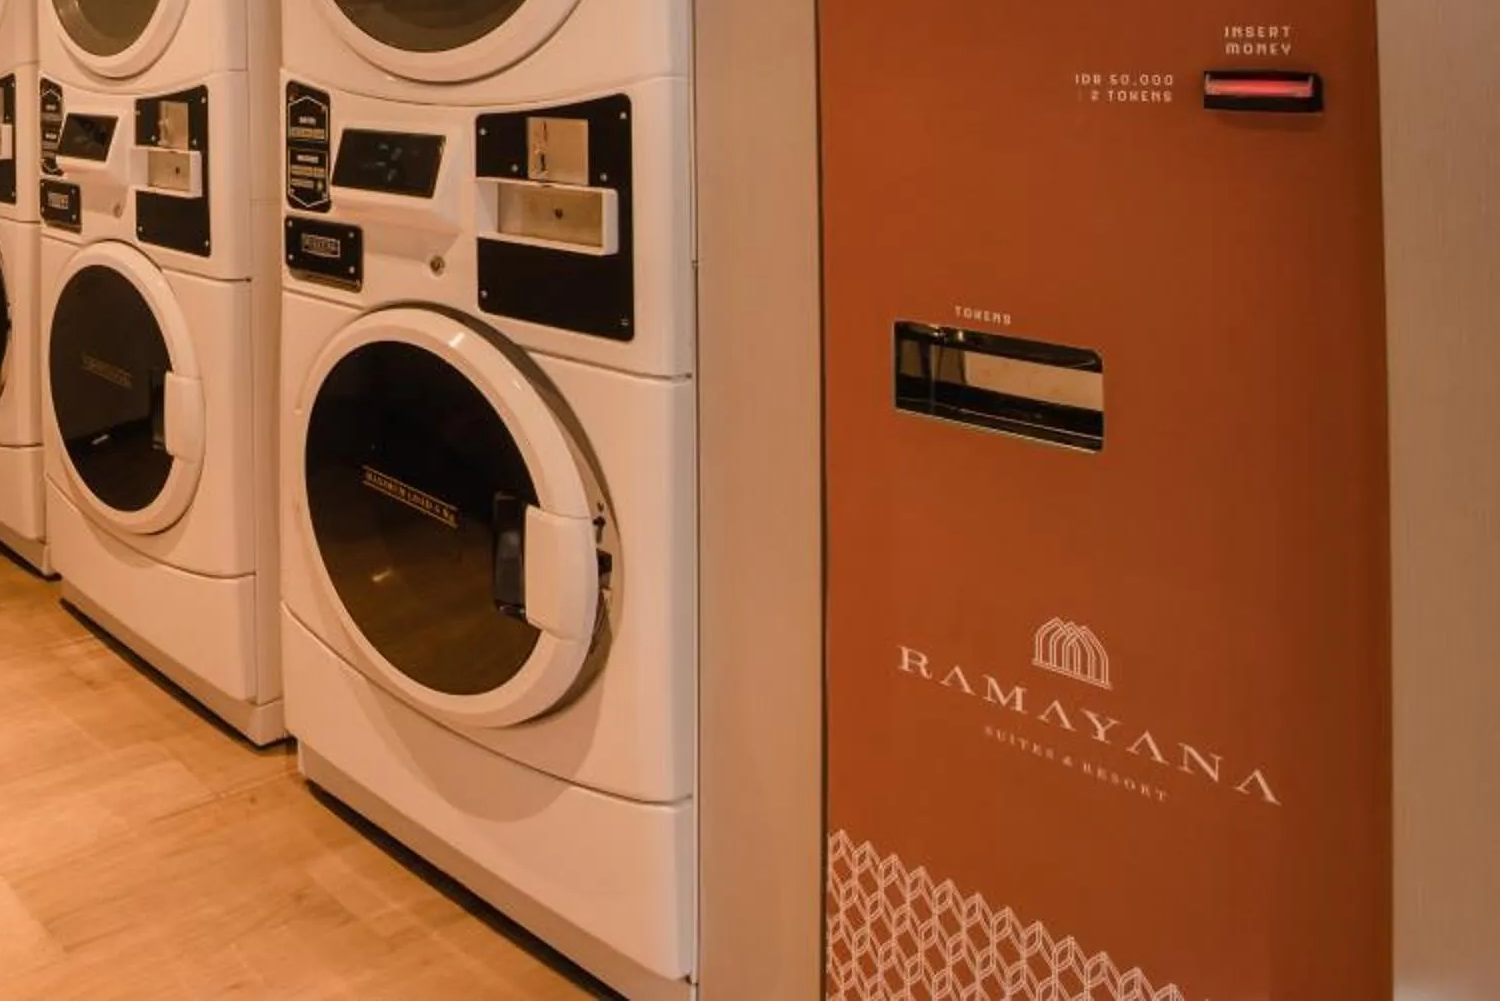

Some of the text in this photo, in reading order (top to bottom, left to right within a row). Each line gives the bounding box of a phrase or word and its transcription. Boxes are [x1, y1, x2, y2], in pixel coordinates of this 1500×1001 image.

[1224, 25, 1291, 39] INSERT
[1225, 42, 1292, 56] MONEY
[1074, 73, 1101, 86] IDR
[1107, 89, 1173, 103] TOKENS
[954, 305, 1012, 326] TOKENS
[898, 645, 1282, 807] RAMAYANA
[984, 725, 1169, 802] SUITES & RESORT
